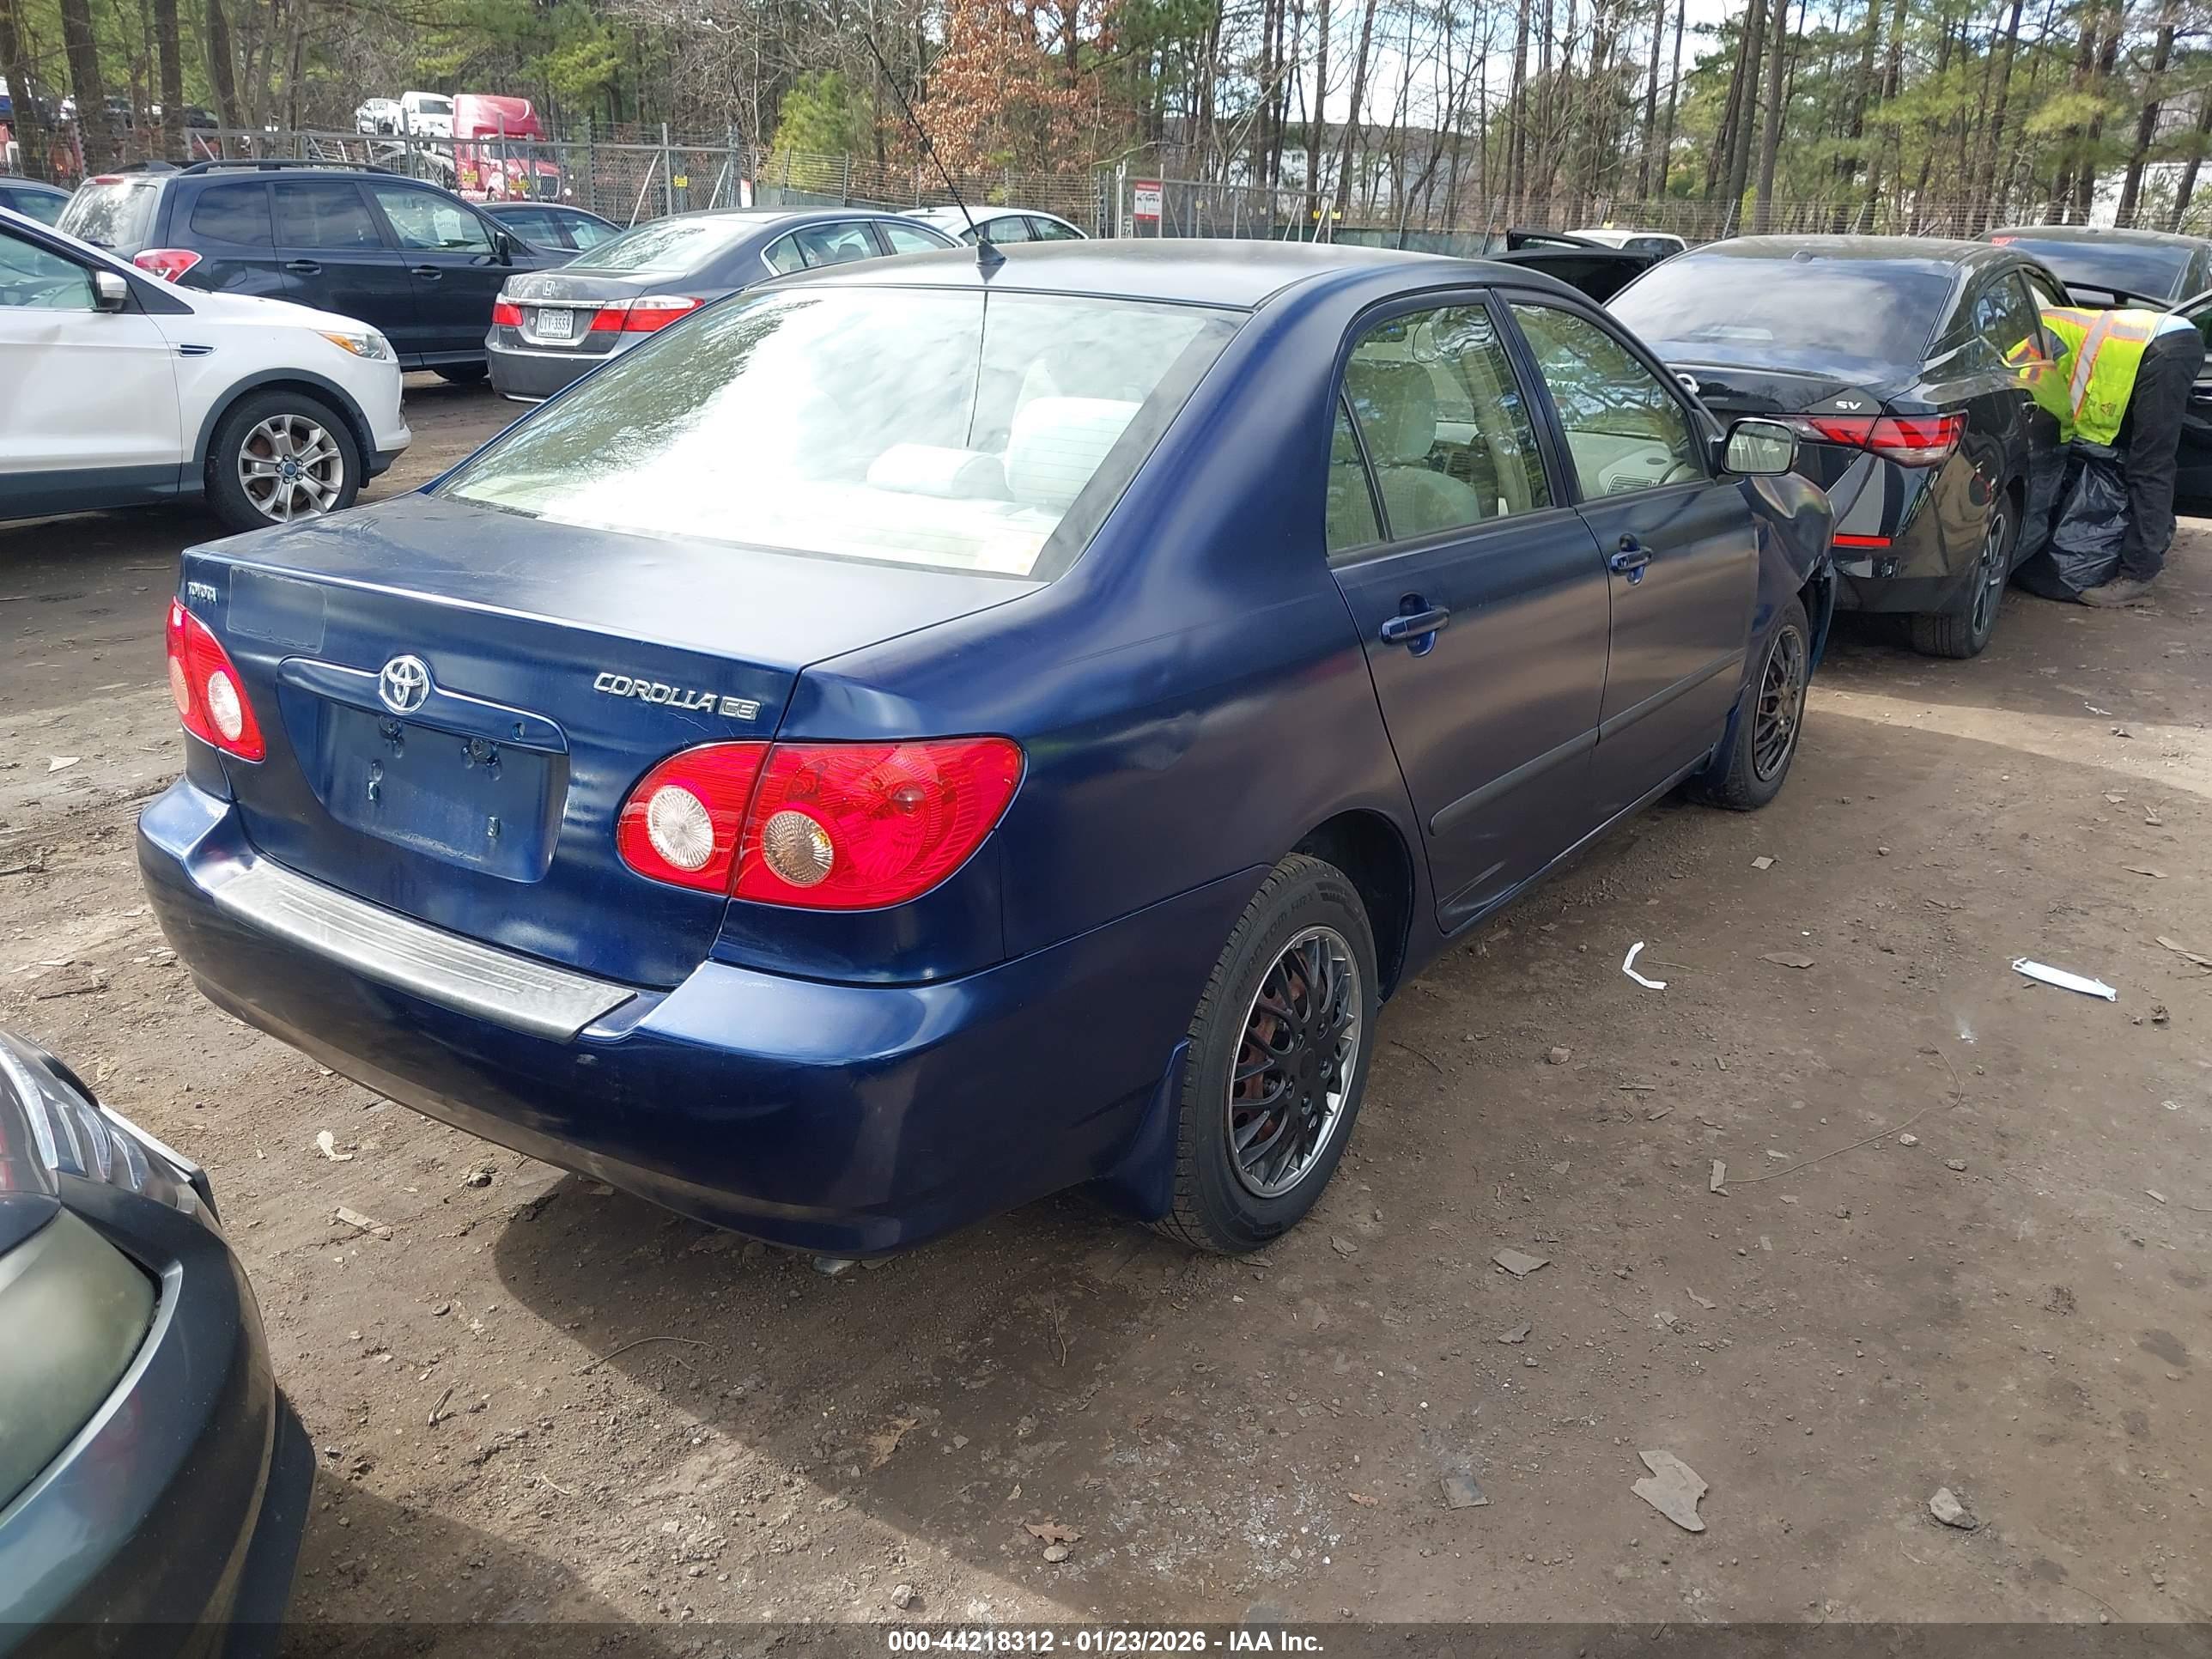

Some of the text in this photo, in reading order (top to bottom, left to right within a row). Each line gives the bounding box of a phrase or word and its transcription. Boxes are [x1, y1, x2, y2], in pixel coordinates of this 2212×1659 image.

[1835, 400, 1862, 410] SV
[593, 672, 761, 720] COROLLA CE
